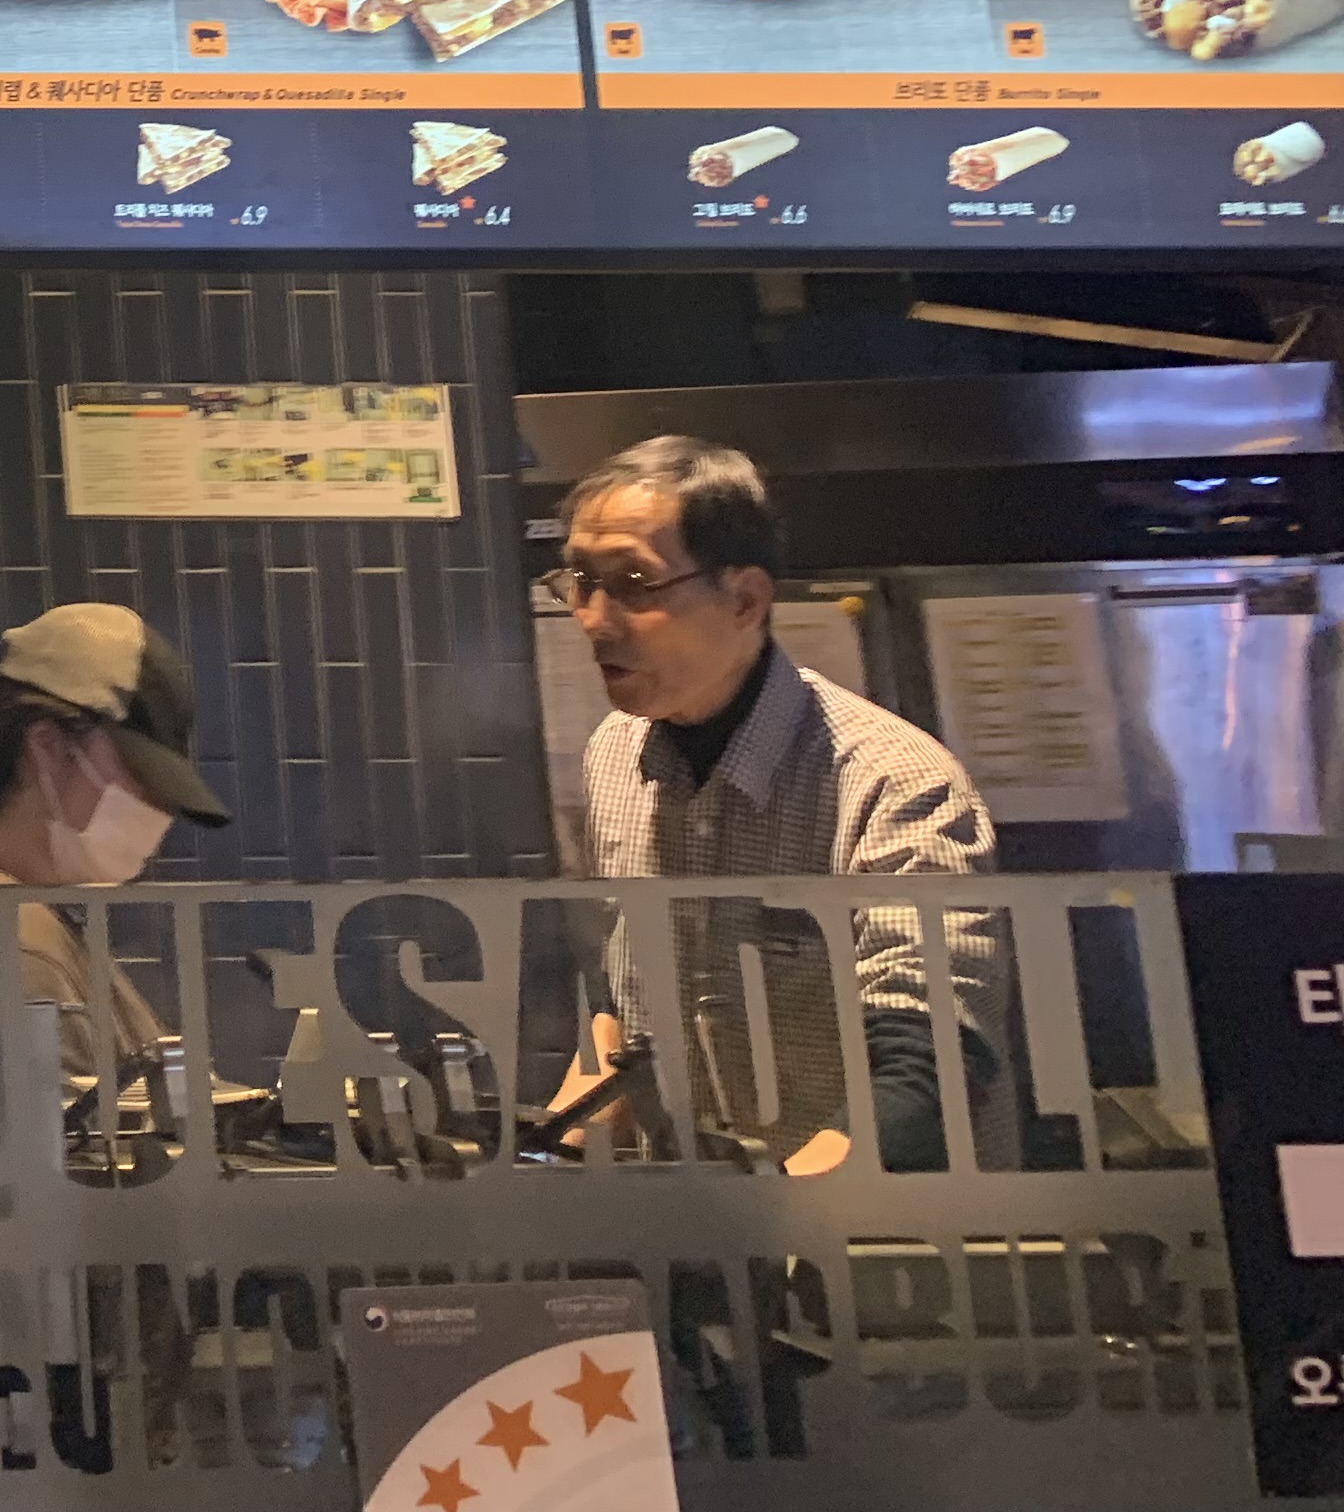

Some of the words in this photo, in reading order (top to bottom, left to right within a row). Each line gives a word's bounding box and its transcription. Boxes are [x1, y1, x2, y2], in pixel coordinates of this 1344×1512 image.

[26, 83, 42, 100] &
[127, 80, 165, 103] 단품
[359, 87, 407, 103] Single
[954, 80, 991, 102] 단품
